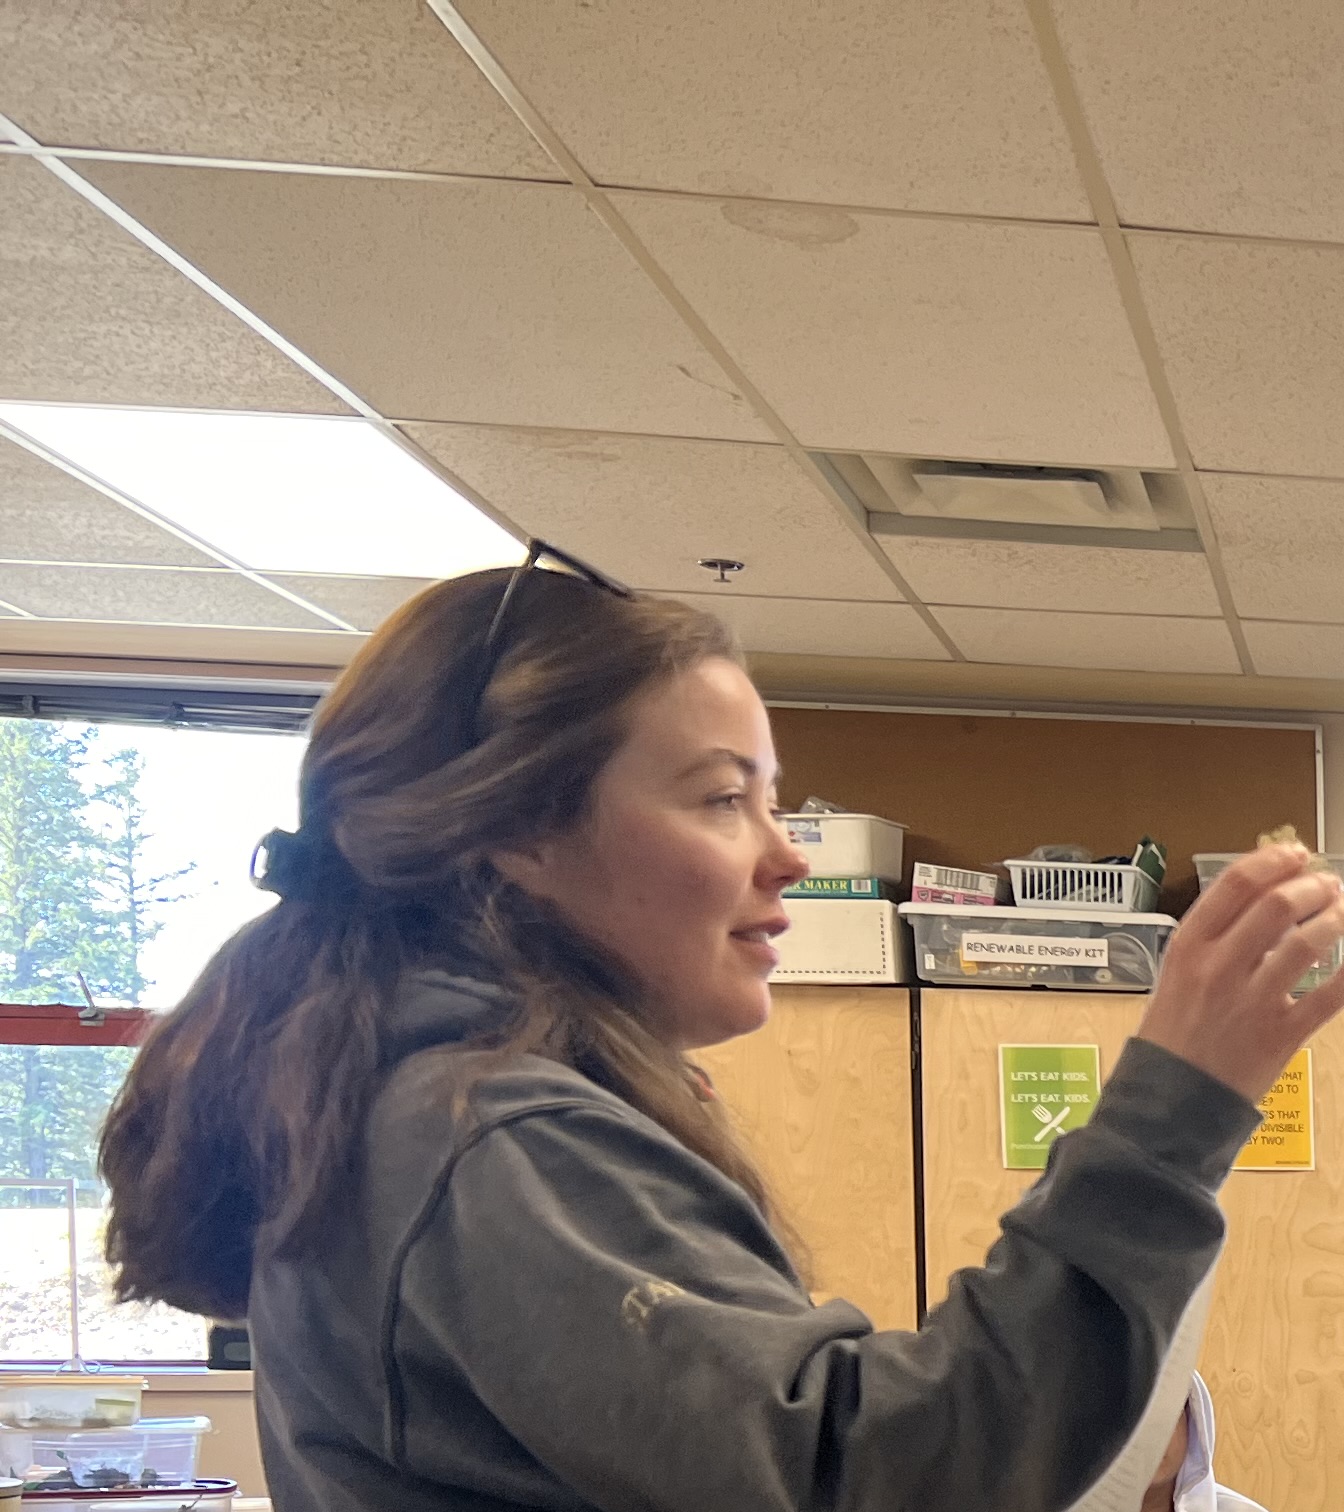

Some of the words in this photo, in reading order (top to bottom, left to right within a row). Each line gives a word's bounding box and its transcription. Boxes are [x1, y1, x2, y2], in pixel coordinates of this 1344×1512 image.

[804, 880, 848, 890] MAKER
[966, 942, 1035, 956] RENEWABLE
[1038, 945, 1081, 957] ENERGY
[1084, 947, 1105, 959] KIT
[1011, 1072, 1038, 1082] LET'S
[1040, 1072, 1060, 1082] EAT
[1286, 1084, 1299, 1094] TO
[1011, 1094, 1038, 1104] LET'S
[1277, 1110, 1301, 1120] THAT
[1261, 1123, 1304, 1133] DIVISIBLE
[1261, 1136, 1285, 1145] TWO!
